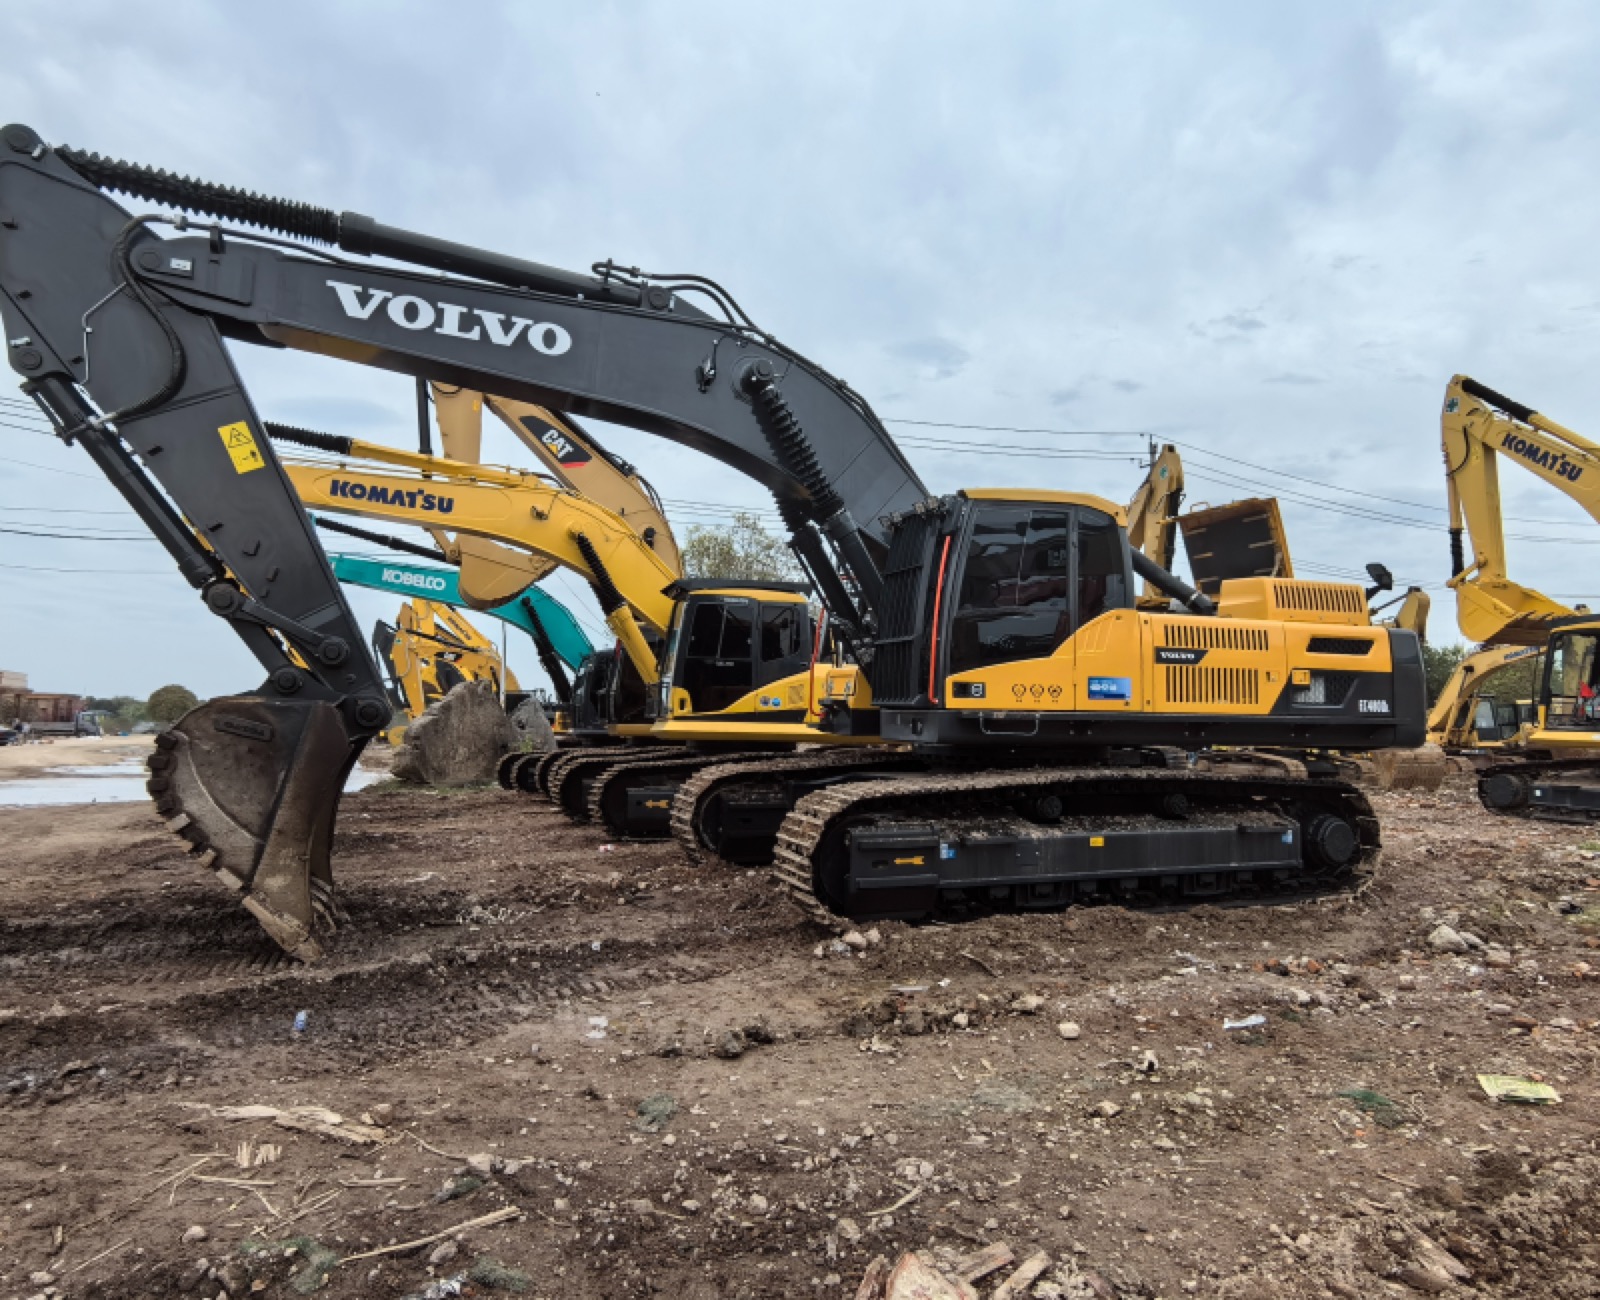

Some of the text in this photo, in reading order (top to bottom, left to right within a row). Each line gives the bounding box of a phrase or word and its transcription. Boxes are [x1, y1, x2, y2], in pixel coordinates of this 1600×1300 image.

[326, 280, 572, 356] VOLVO
[542, 430, 574, 458] CAT
[1502, 432, 1583, 482] KOMATSU
[329, 479, 455, 513] KOMATSU
[381, 567, 447, 591] KOBELCO
[1159, 651, 1195, 660] VOLVO
